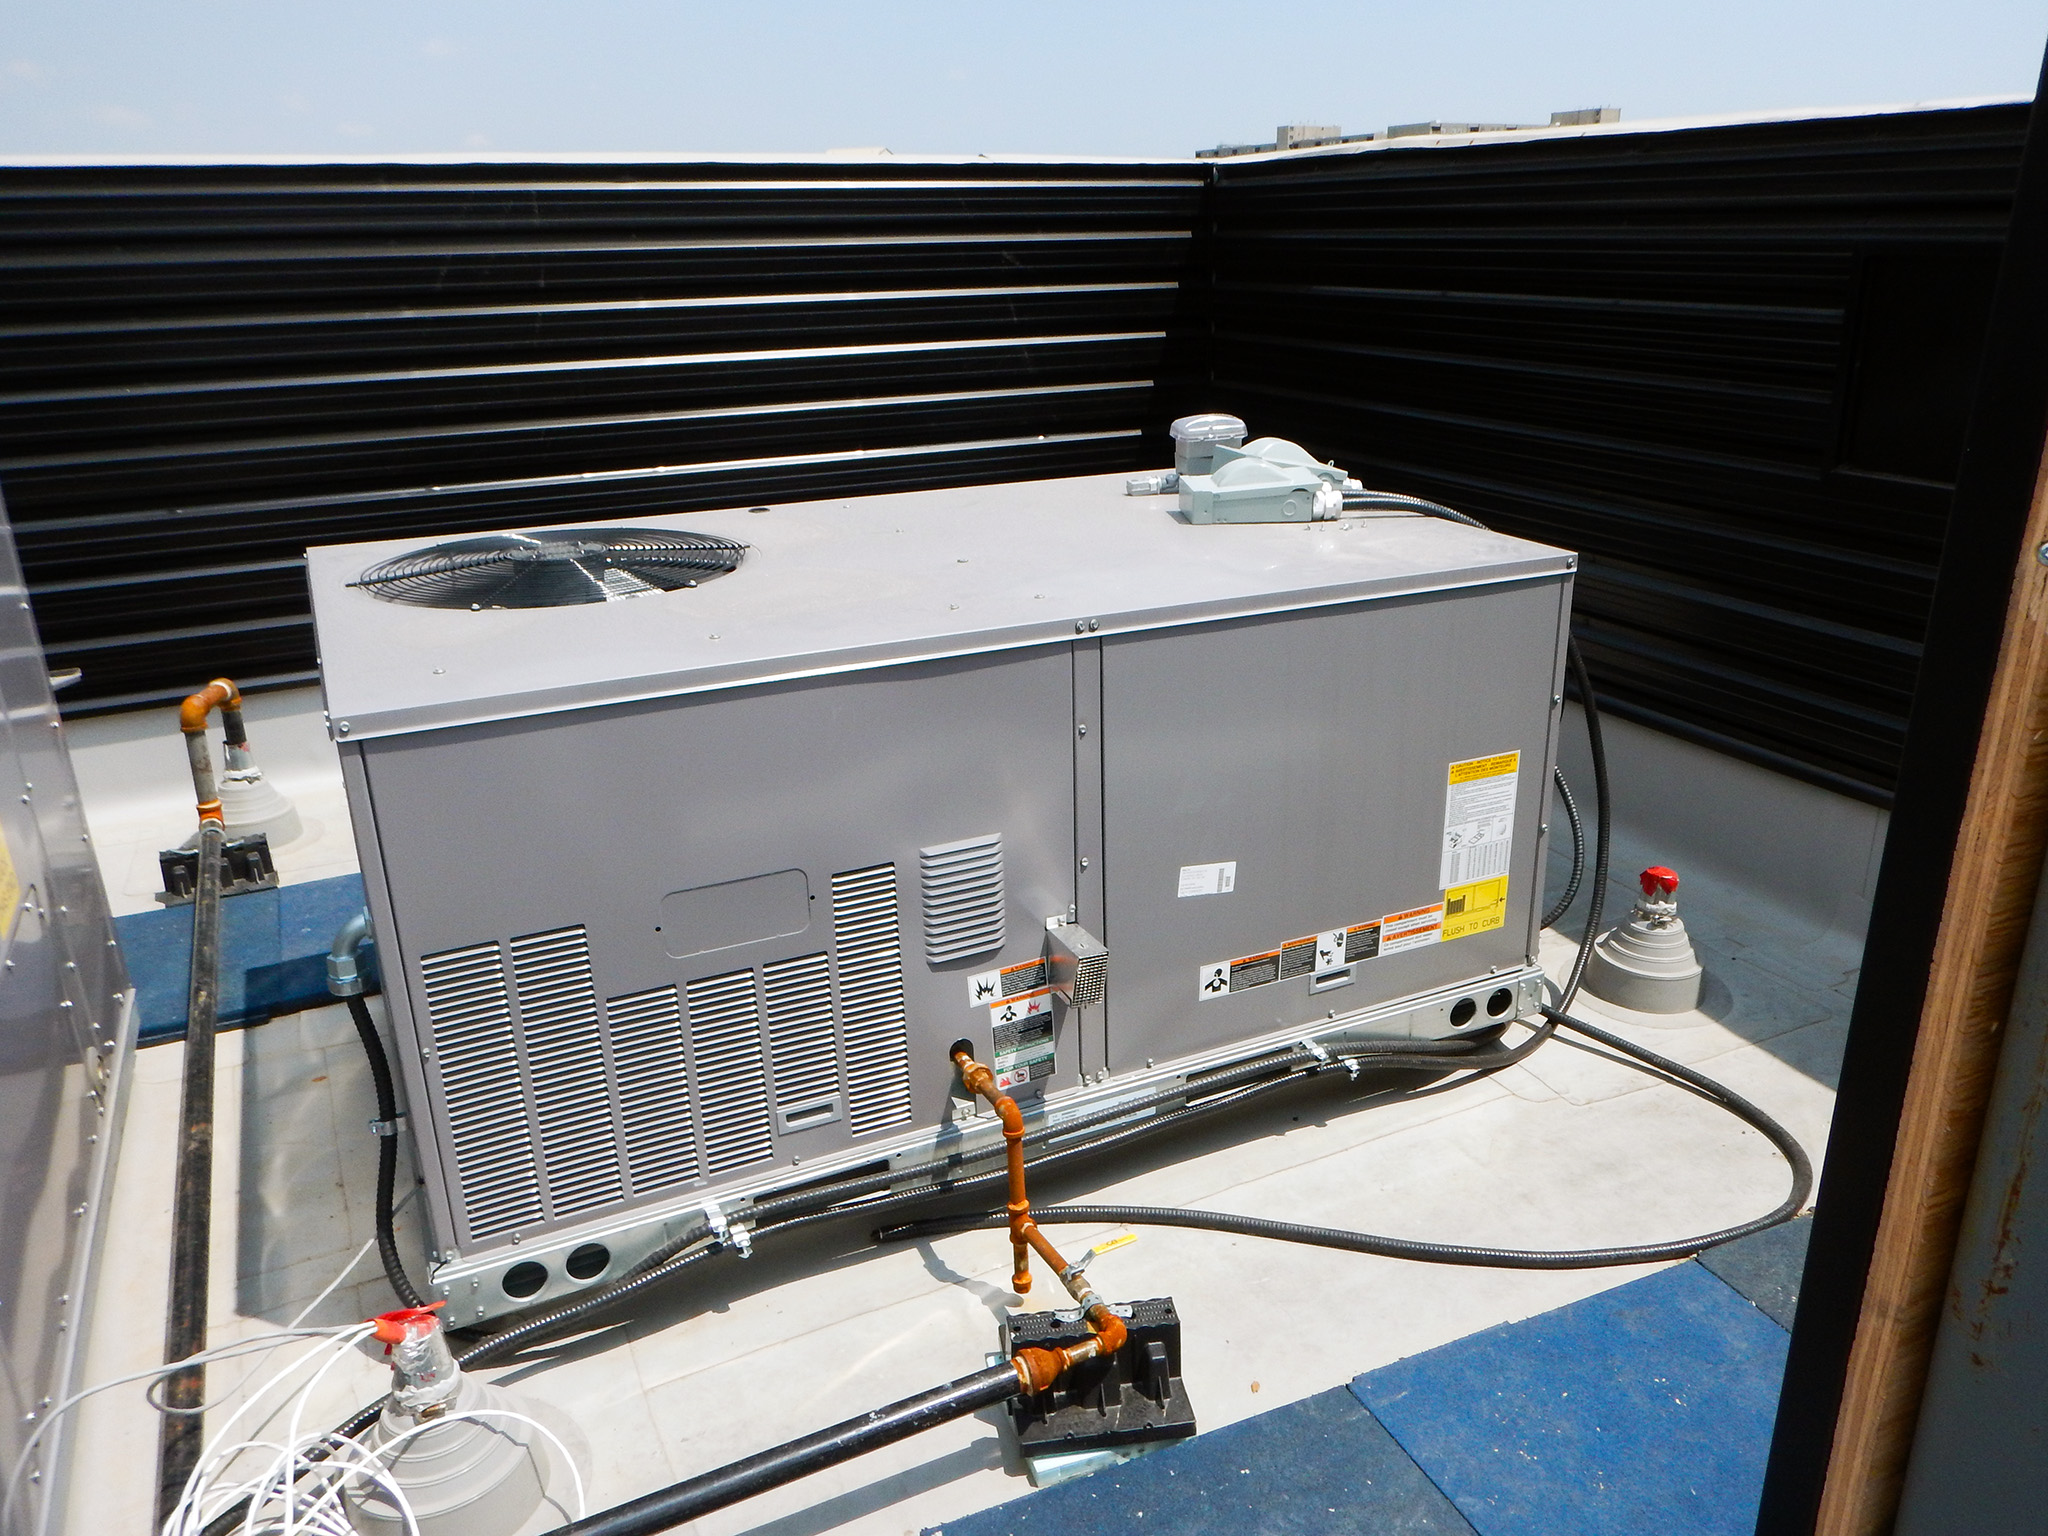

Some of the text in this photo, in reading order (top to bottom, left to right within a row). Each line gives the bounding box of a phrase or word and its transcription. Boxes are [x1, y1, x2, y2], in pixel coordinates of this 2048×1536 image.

[1402, 908, 1430, 918] WARNING
[1393, 924, 1436, 938] AVERTISSEMENT
[1442, 916, 1500, 938] FLUSH TO CURB
[1000, 1048, 1017, 1056] SAFETY
[1017, 1038, 1050, 1050] INSTRUCTIONS
[1029, 1056, 1048, 1064] SAFETY
